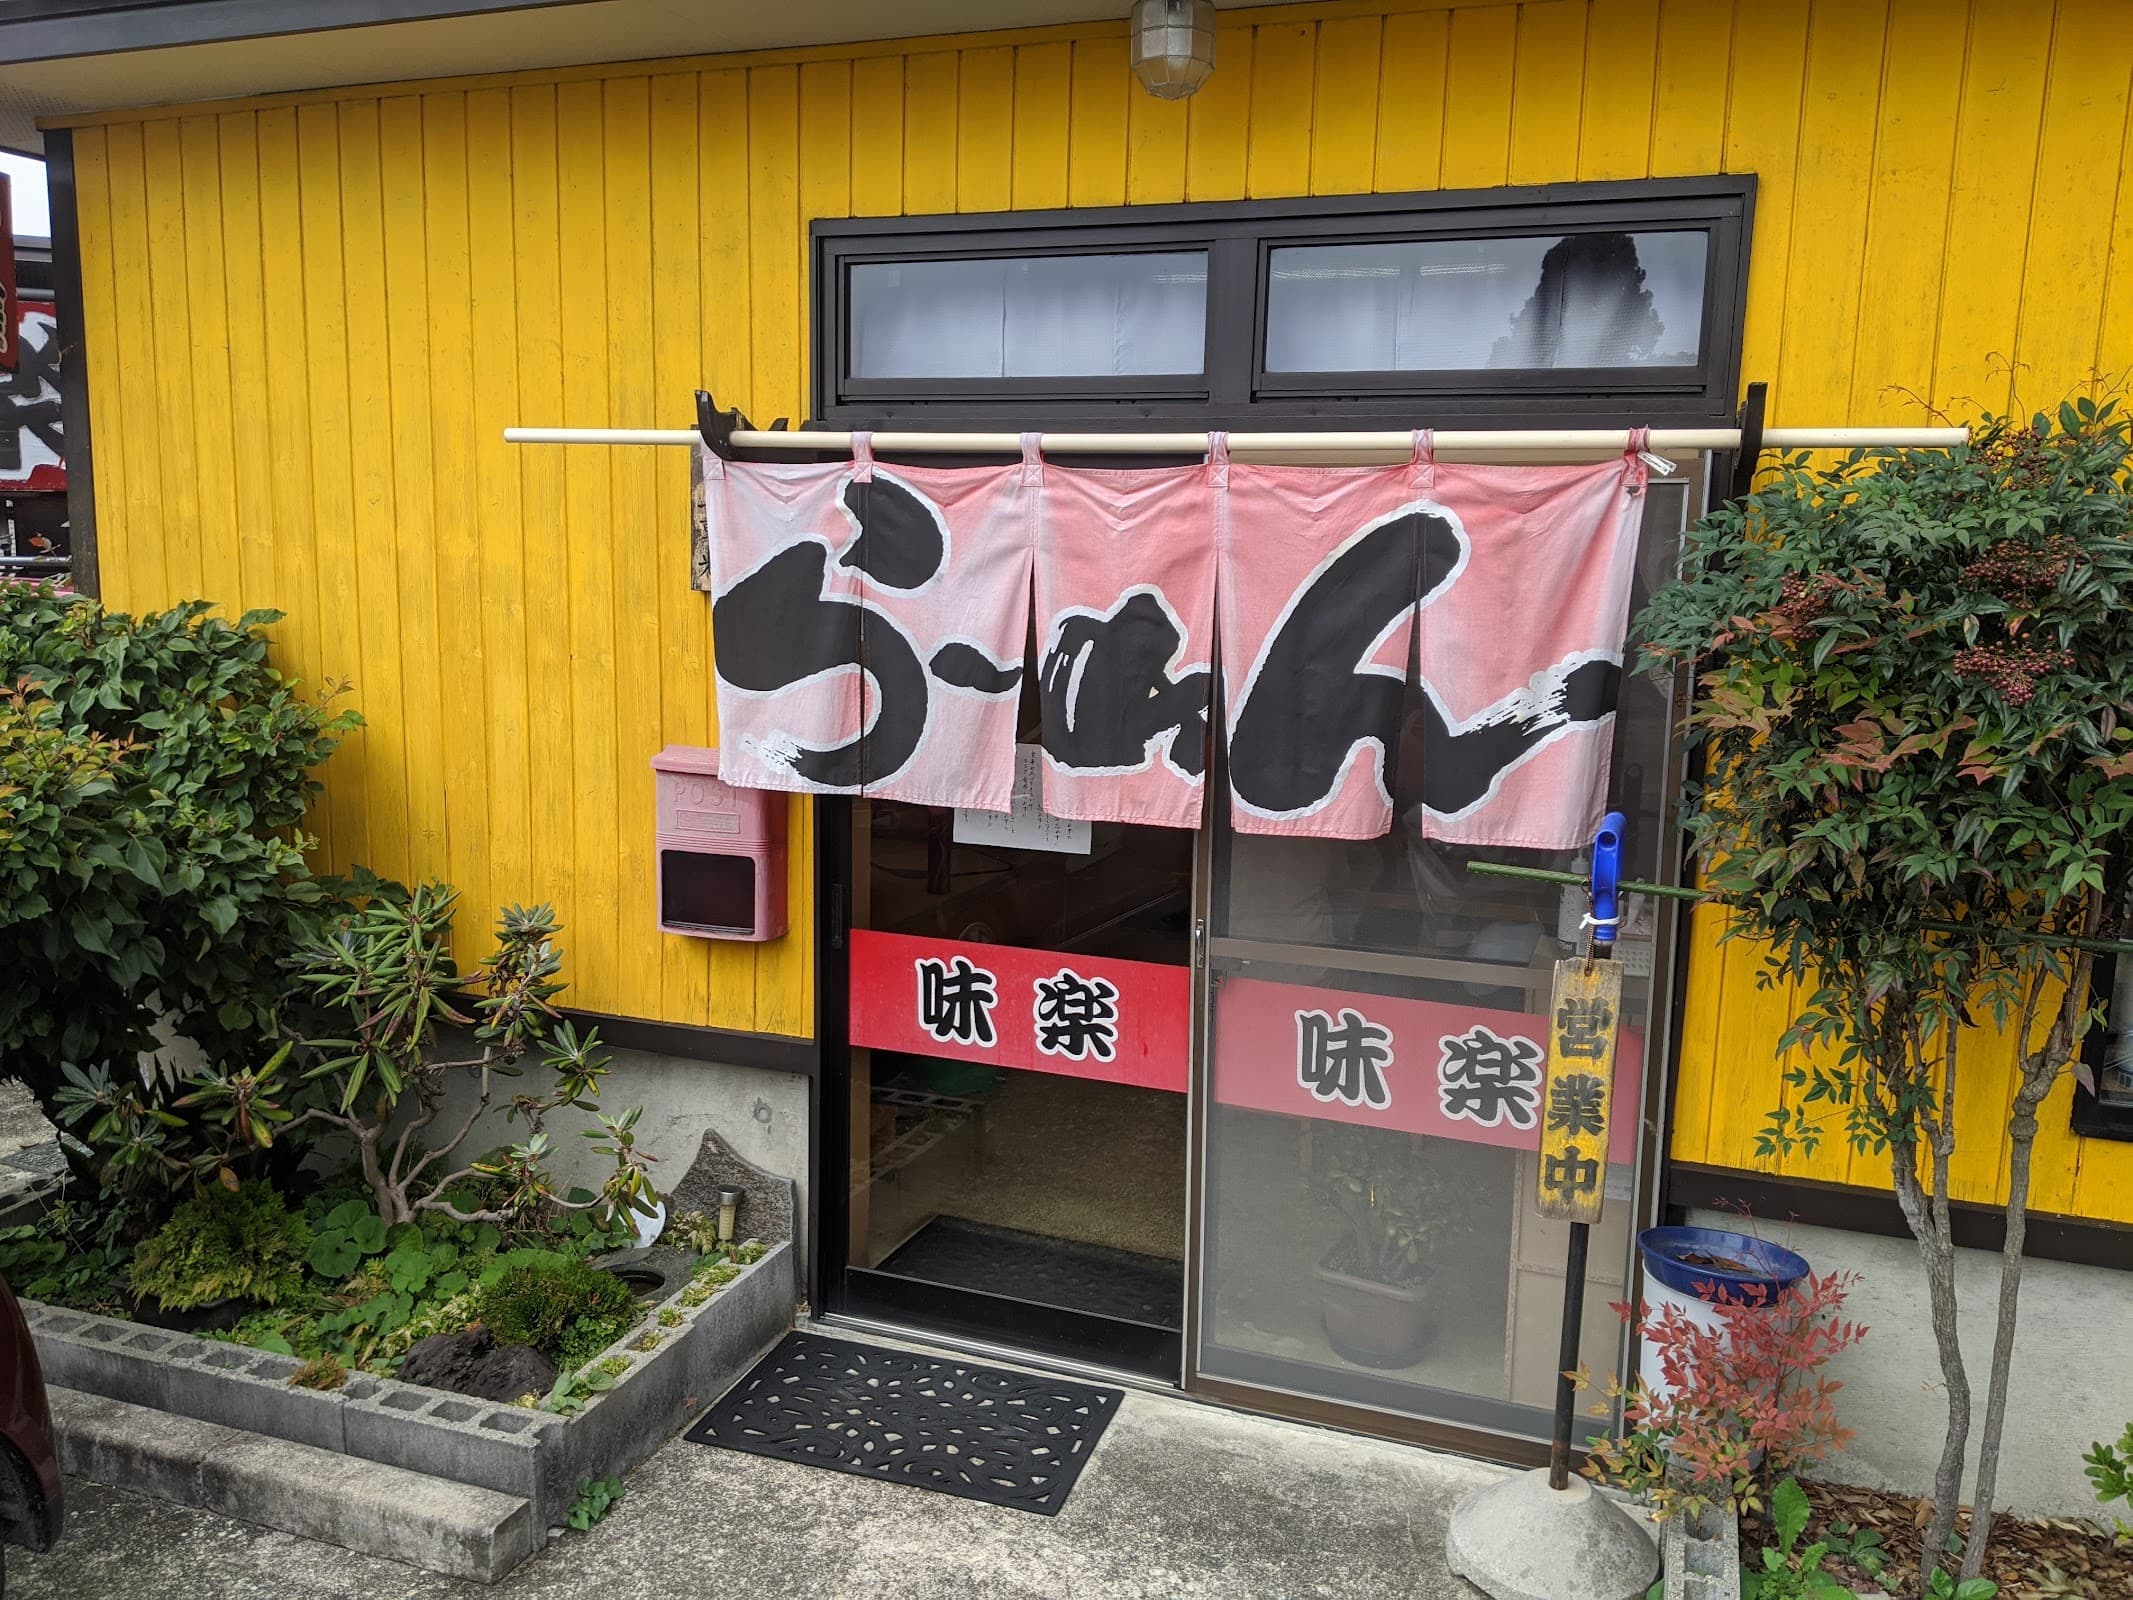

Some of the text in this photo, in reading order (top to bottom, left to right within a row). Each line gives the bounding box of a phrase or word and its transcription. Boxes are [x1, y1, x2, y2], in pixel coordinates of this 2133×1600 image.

[711, 473, 1624, 816] らーめん
[916, 956, 1119, 1062] 味楽
[1295, 1008, 1545, 1129] 味楽
[1544, 996, 1612, 1206] 営業中
